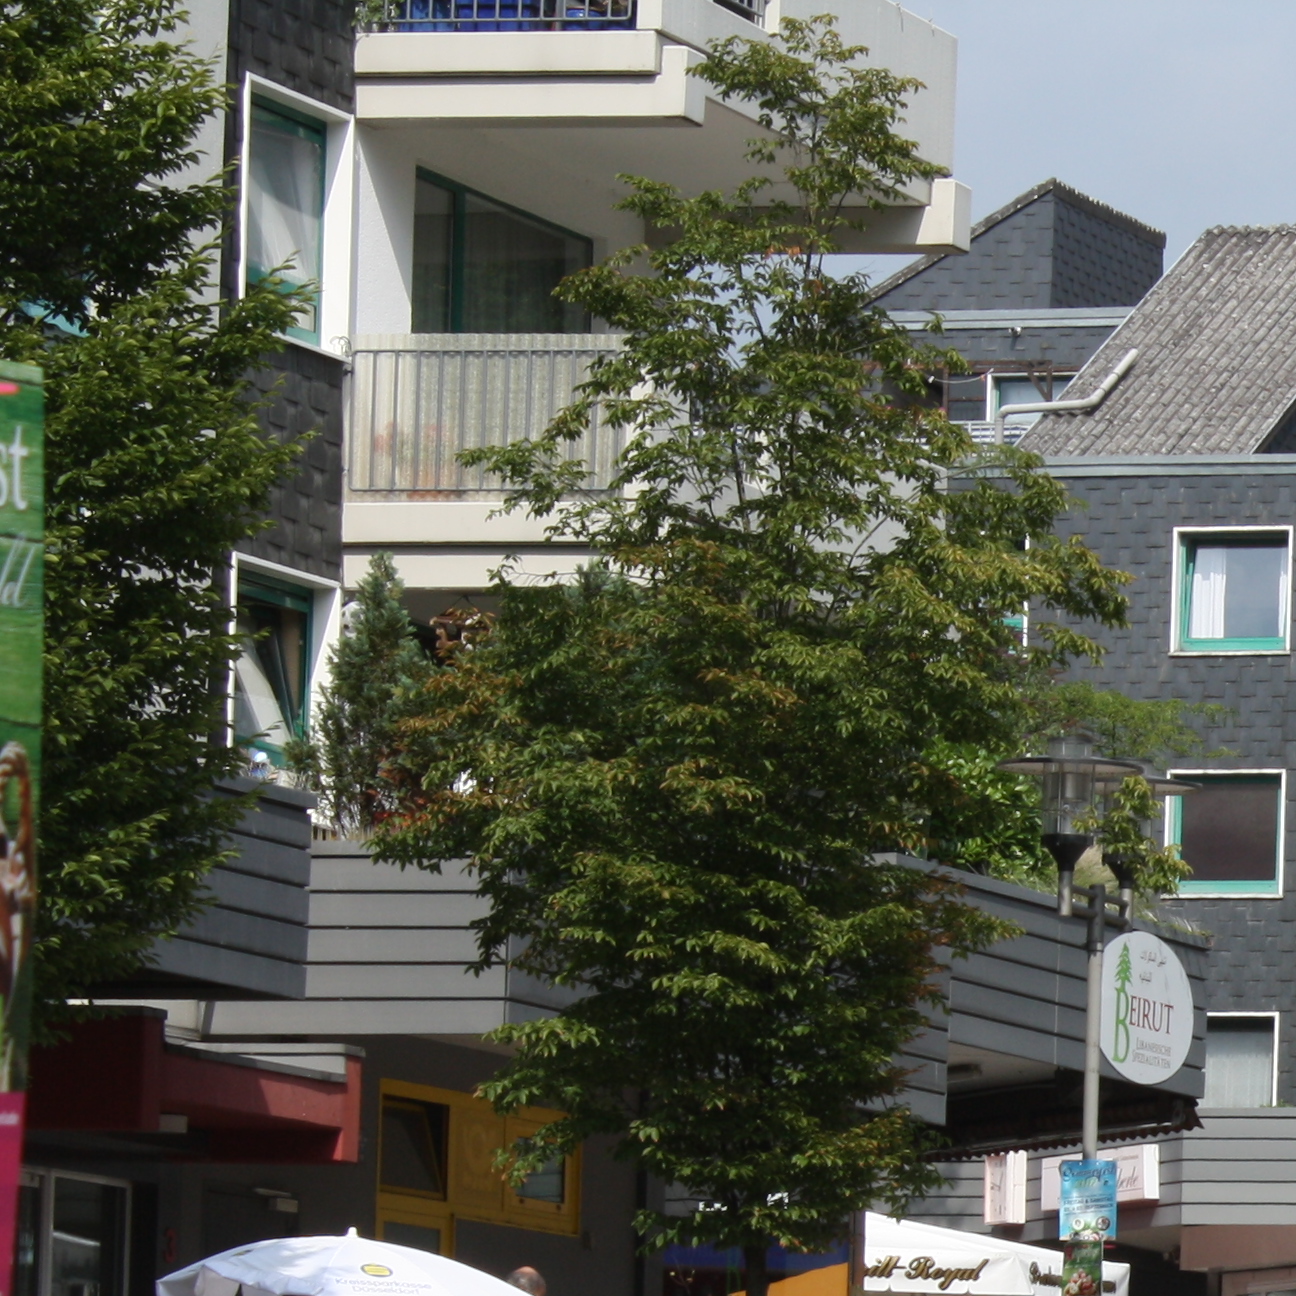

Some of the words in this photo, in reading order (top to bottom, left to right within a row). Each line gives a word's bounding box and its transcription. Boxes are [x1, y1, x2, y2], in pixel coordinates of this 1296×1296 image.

[1112, 987, 1174, 1064] BEIRUT
[334, 1277, 433, 1291] Kreissparkasse
[864, 1256, 989, 1290] ill-Royal
[352, 1285, 421, 1296] Düsseldorf
